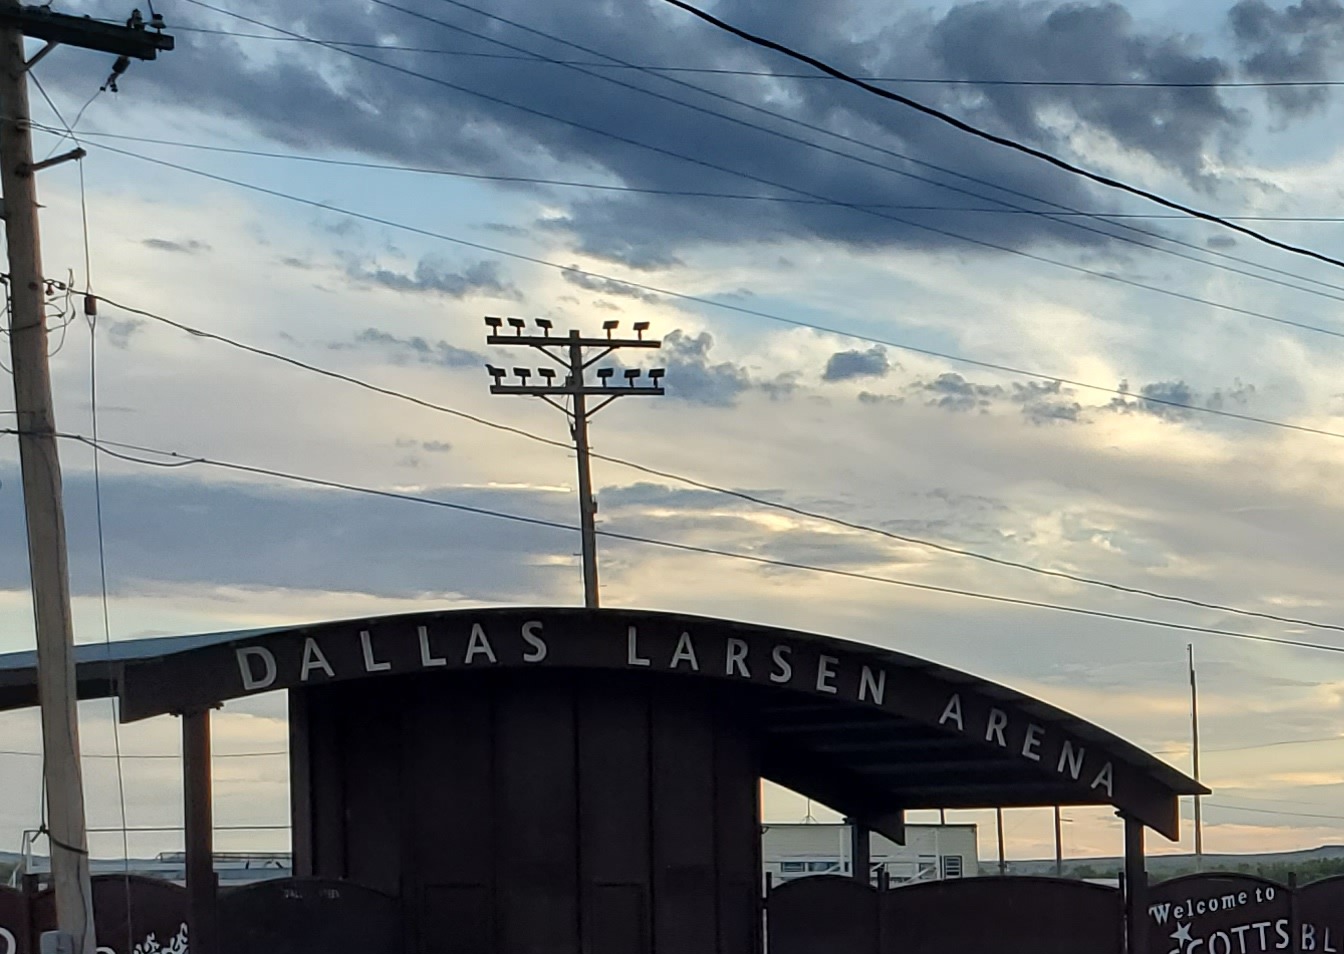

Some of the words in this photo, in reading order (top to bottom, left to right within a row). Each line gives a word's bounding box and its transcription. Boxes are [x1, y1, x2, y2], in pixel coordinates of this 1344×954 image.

[236, 620, 548, 690] DALLAS
[626, 625, 887, 705] LARSEN
[939, 693, 1114, 797] ARENA
[1148, 890, 1248, 925] Welcome
[1255, 887, 1275, 903] to
